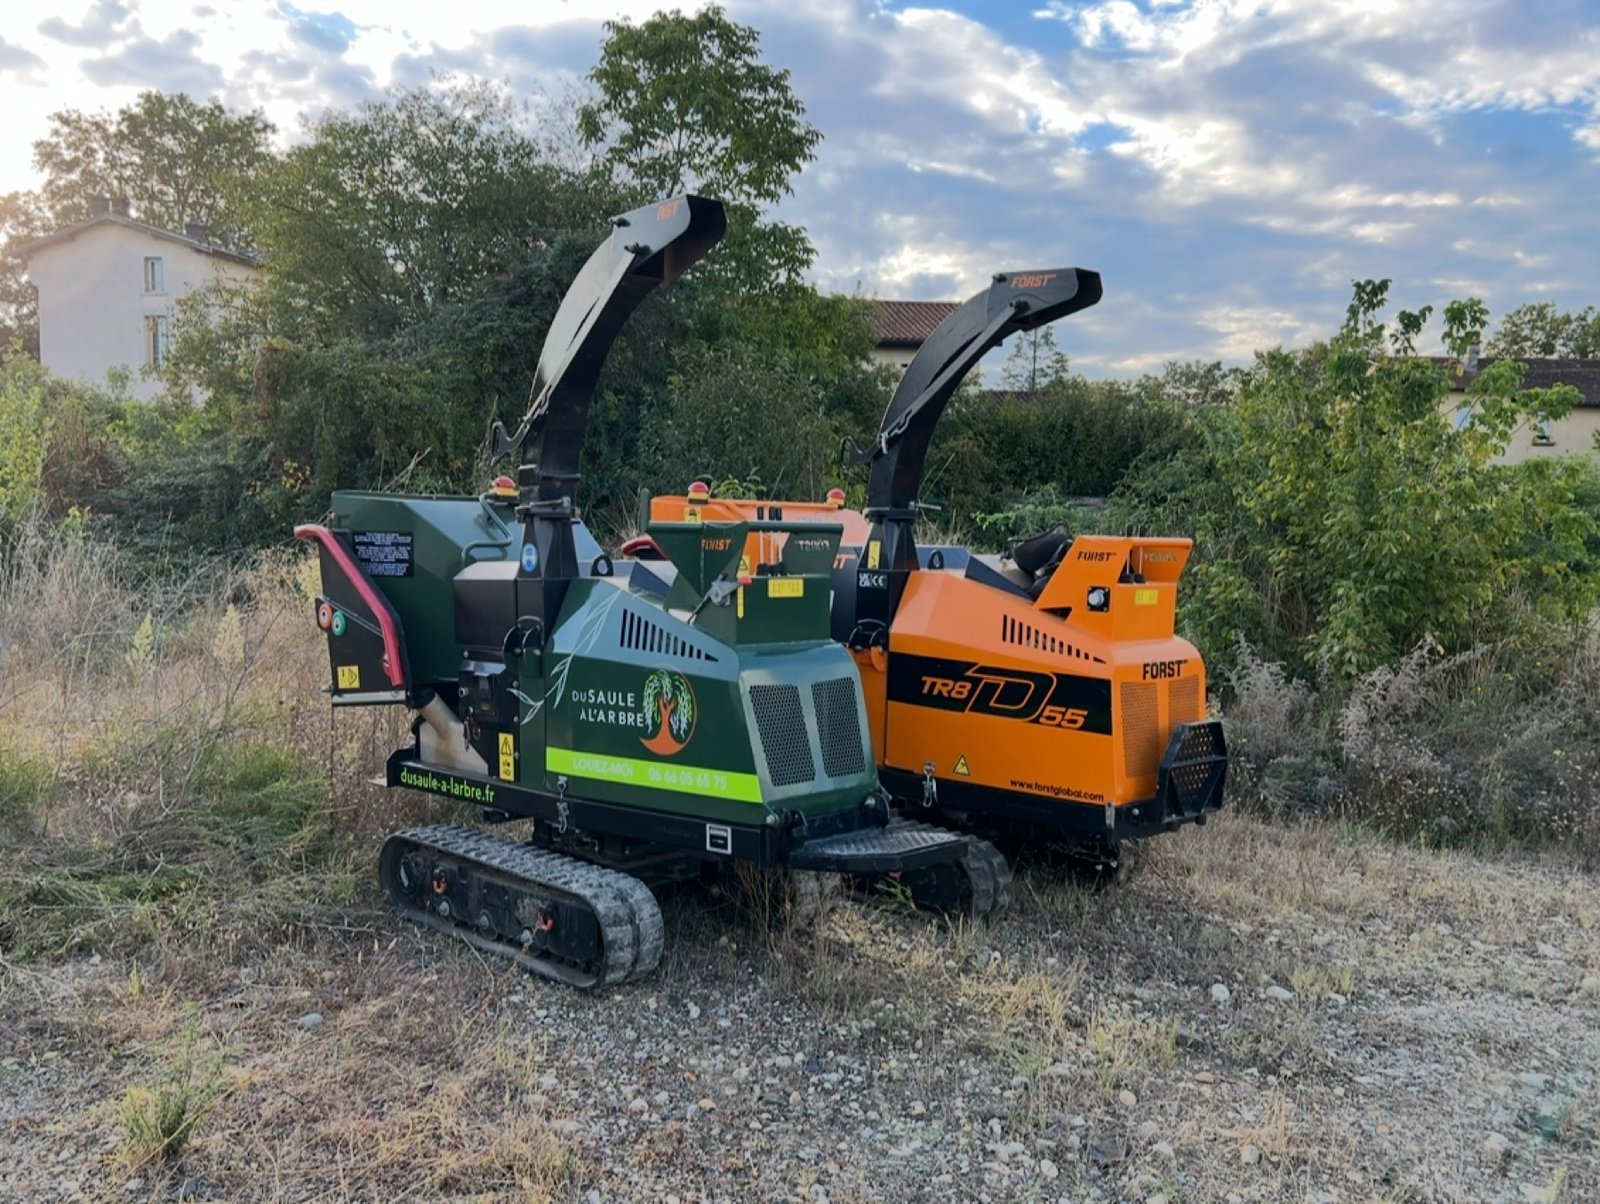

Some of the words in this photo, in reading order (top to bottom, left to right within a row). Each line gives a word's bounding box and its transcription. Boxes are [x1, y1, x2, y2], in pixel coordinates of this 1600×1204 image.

[921, 675, 972, 699] TR8
[1038, 705, 1089, 729] 55
[400, 766, 495, 803] dusaule-a-larbre.fr
[572, 756, 634, 777] LOUEZ-MOI
[647, 767, 662, 782] 06
[713, 776, 727, 791] 75
[1009, 779, 1104, 802] www.forstglobal.com
